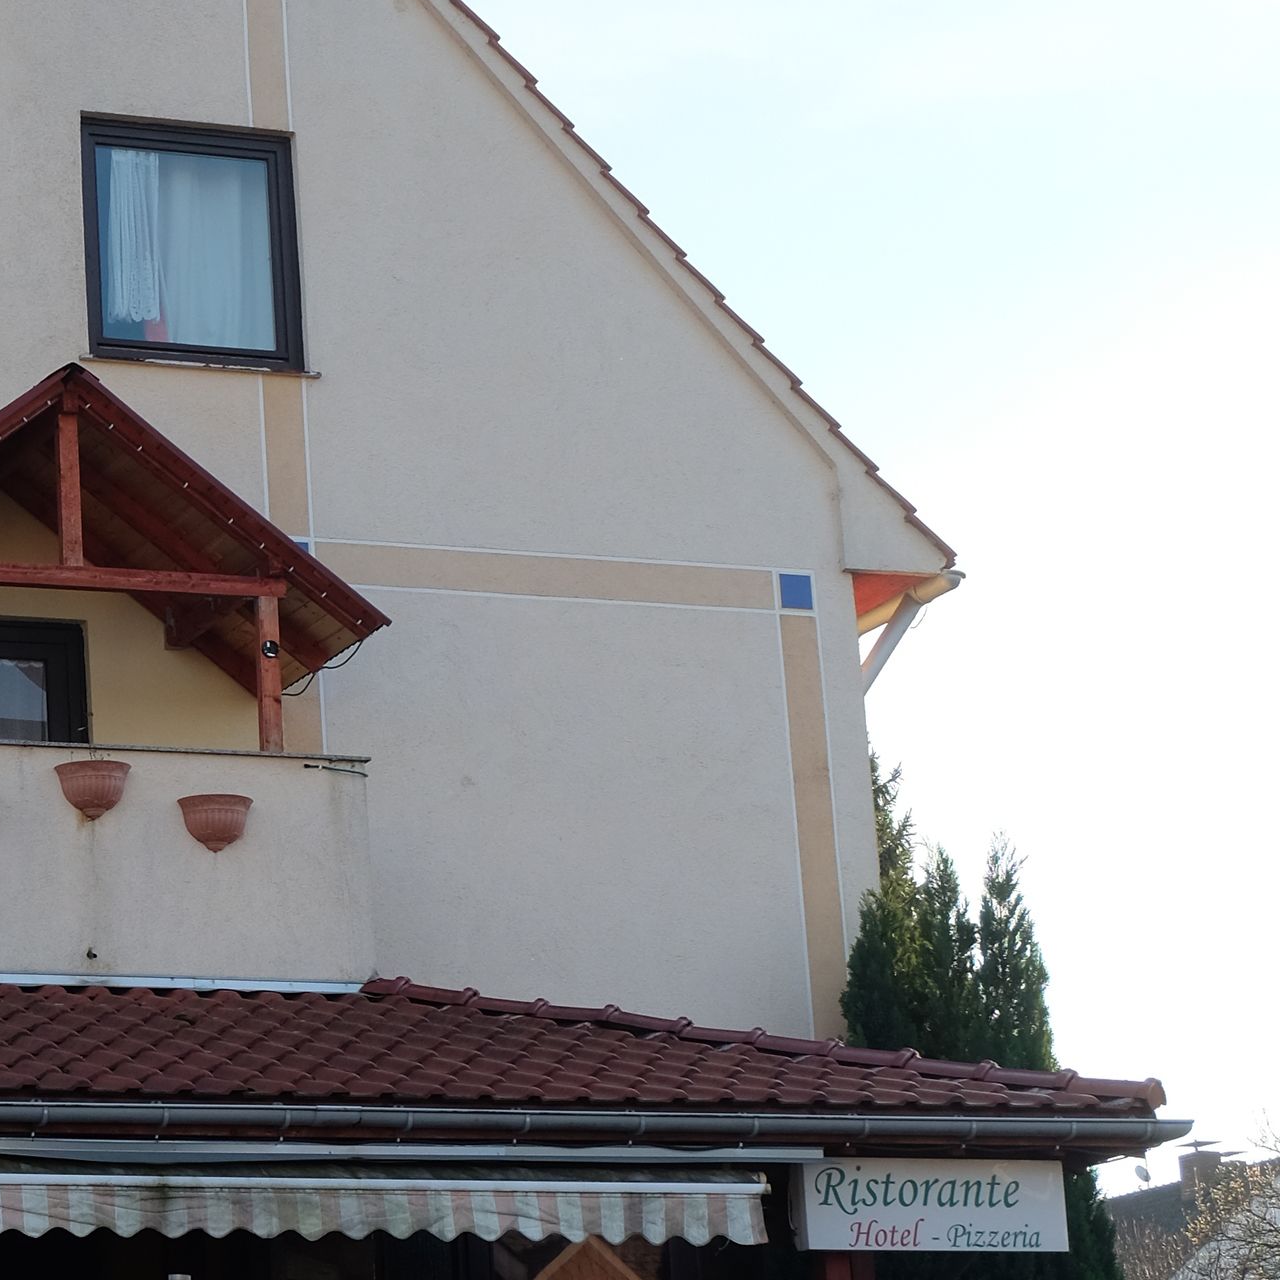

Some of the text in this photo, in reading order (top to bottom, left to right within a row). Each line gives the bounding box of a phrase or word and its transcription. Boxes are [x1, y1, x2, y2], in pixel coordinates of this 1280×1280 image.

[814, 1165, 1020, 1215] Ristorante
[849, 1218, 925, 1248] Hotel
[946, 1222, 1042, 1249] Pizzeria
